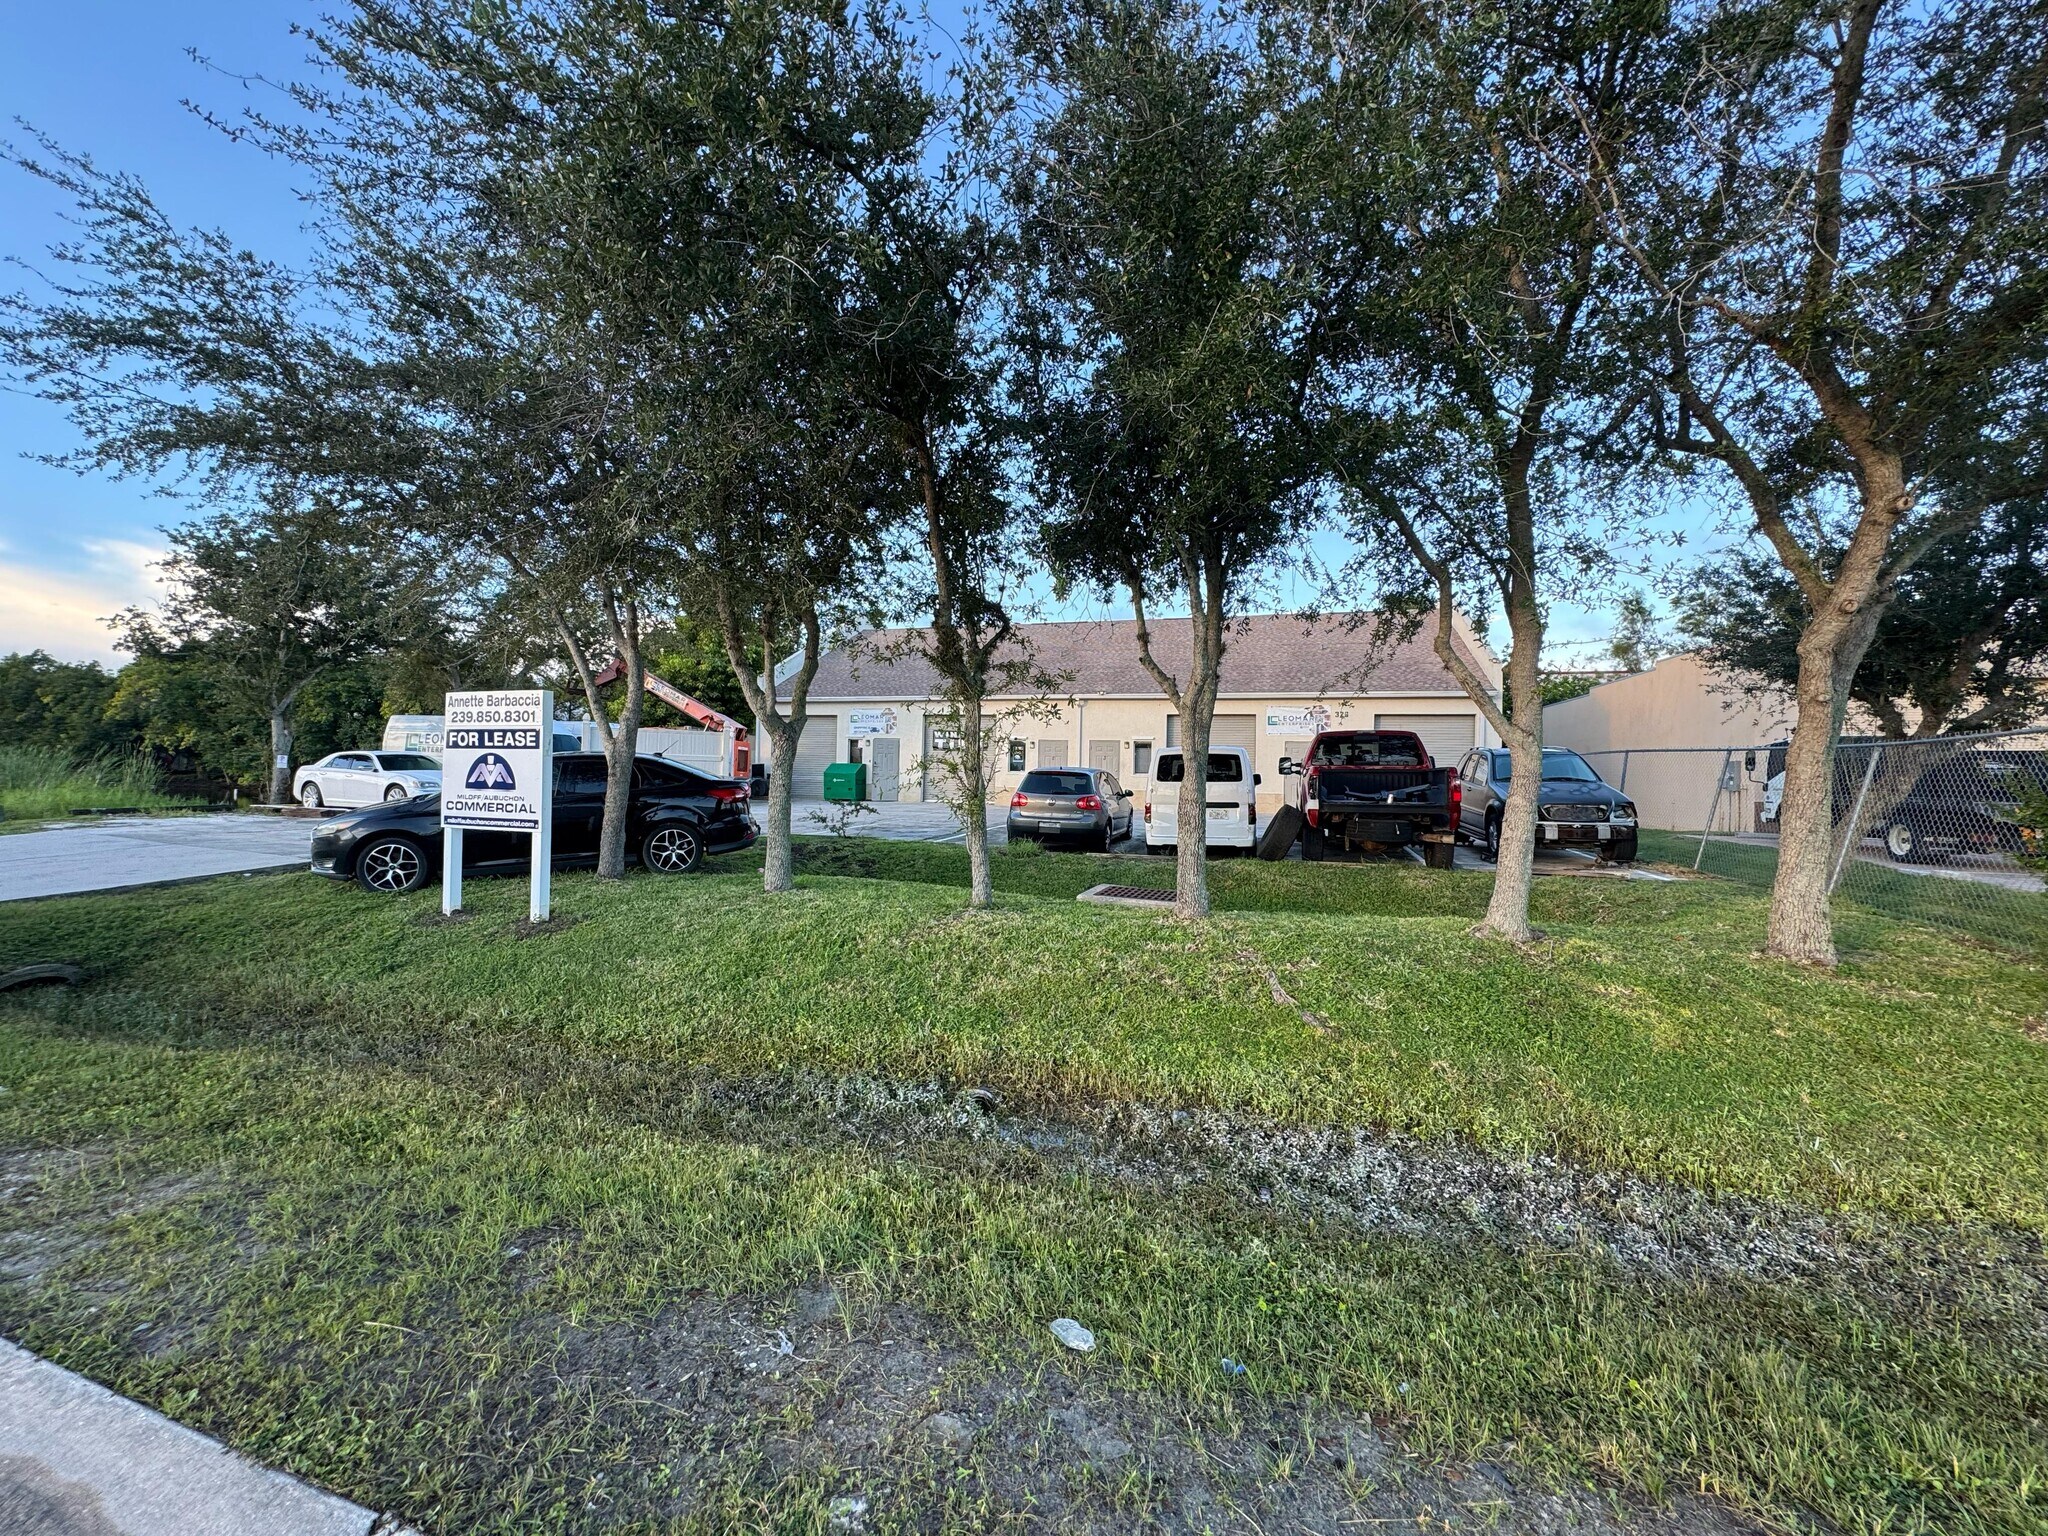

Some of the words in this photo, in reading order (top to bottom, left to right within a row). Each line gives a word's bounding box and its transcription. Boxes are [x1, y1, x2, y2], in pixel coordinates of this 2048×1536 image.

[447, 695, 484, 708] Annette
[486, 694, 541, 707] Barbaccia
[451, 710, 536, 723] 239.850.8301
[448, 731, 479, 747] FOR
[484, 731, 537, 747] LEASE
[456, 794, 525, 802] MILOFF/AUBUCHON
[446, 800, 537, 814] COMMERCIAL
[447, 817, 535, 828] miloffaubuchoncommercial.com
